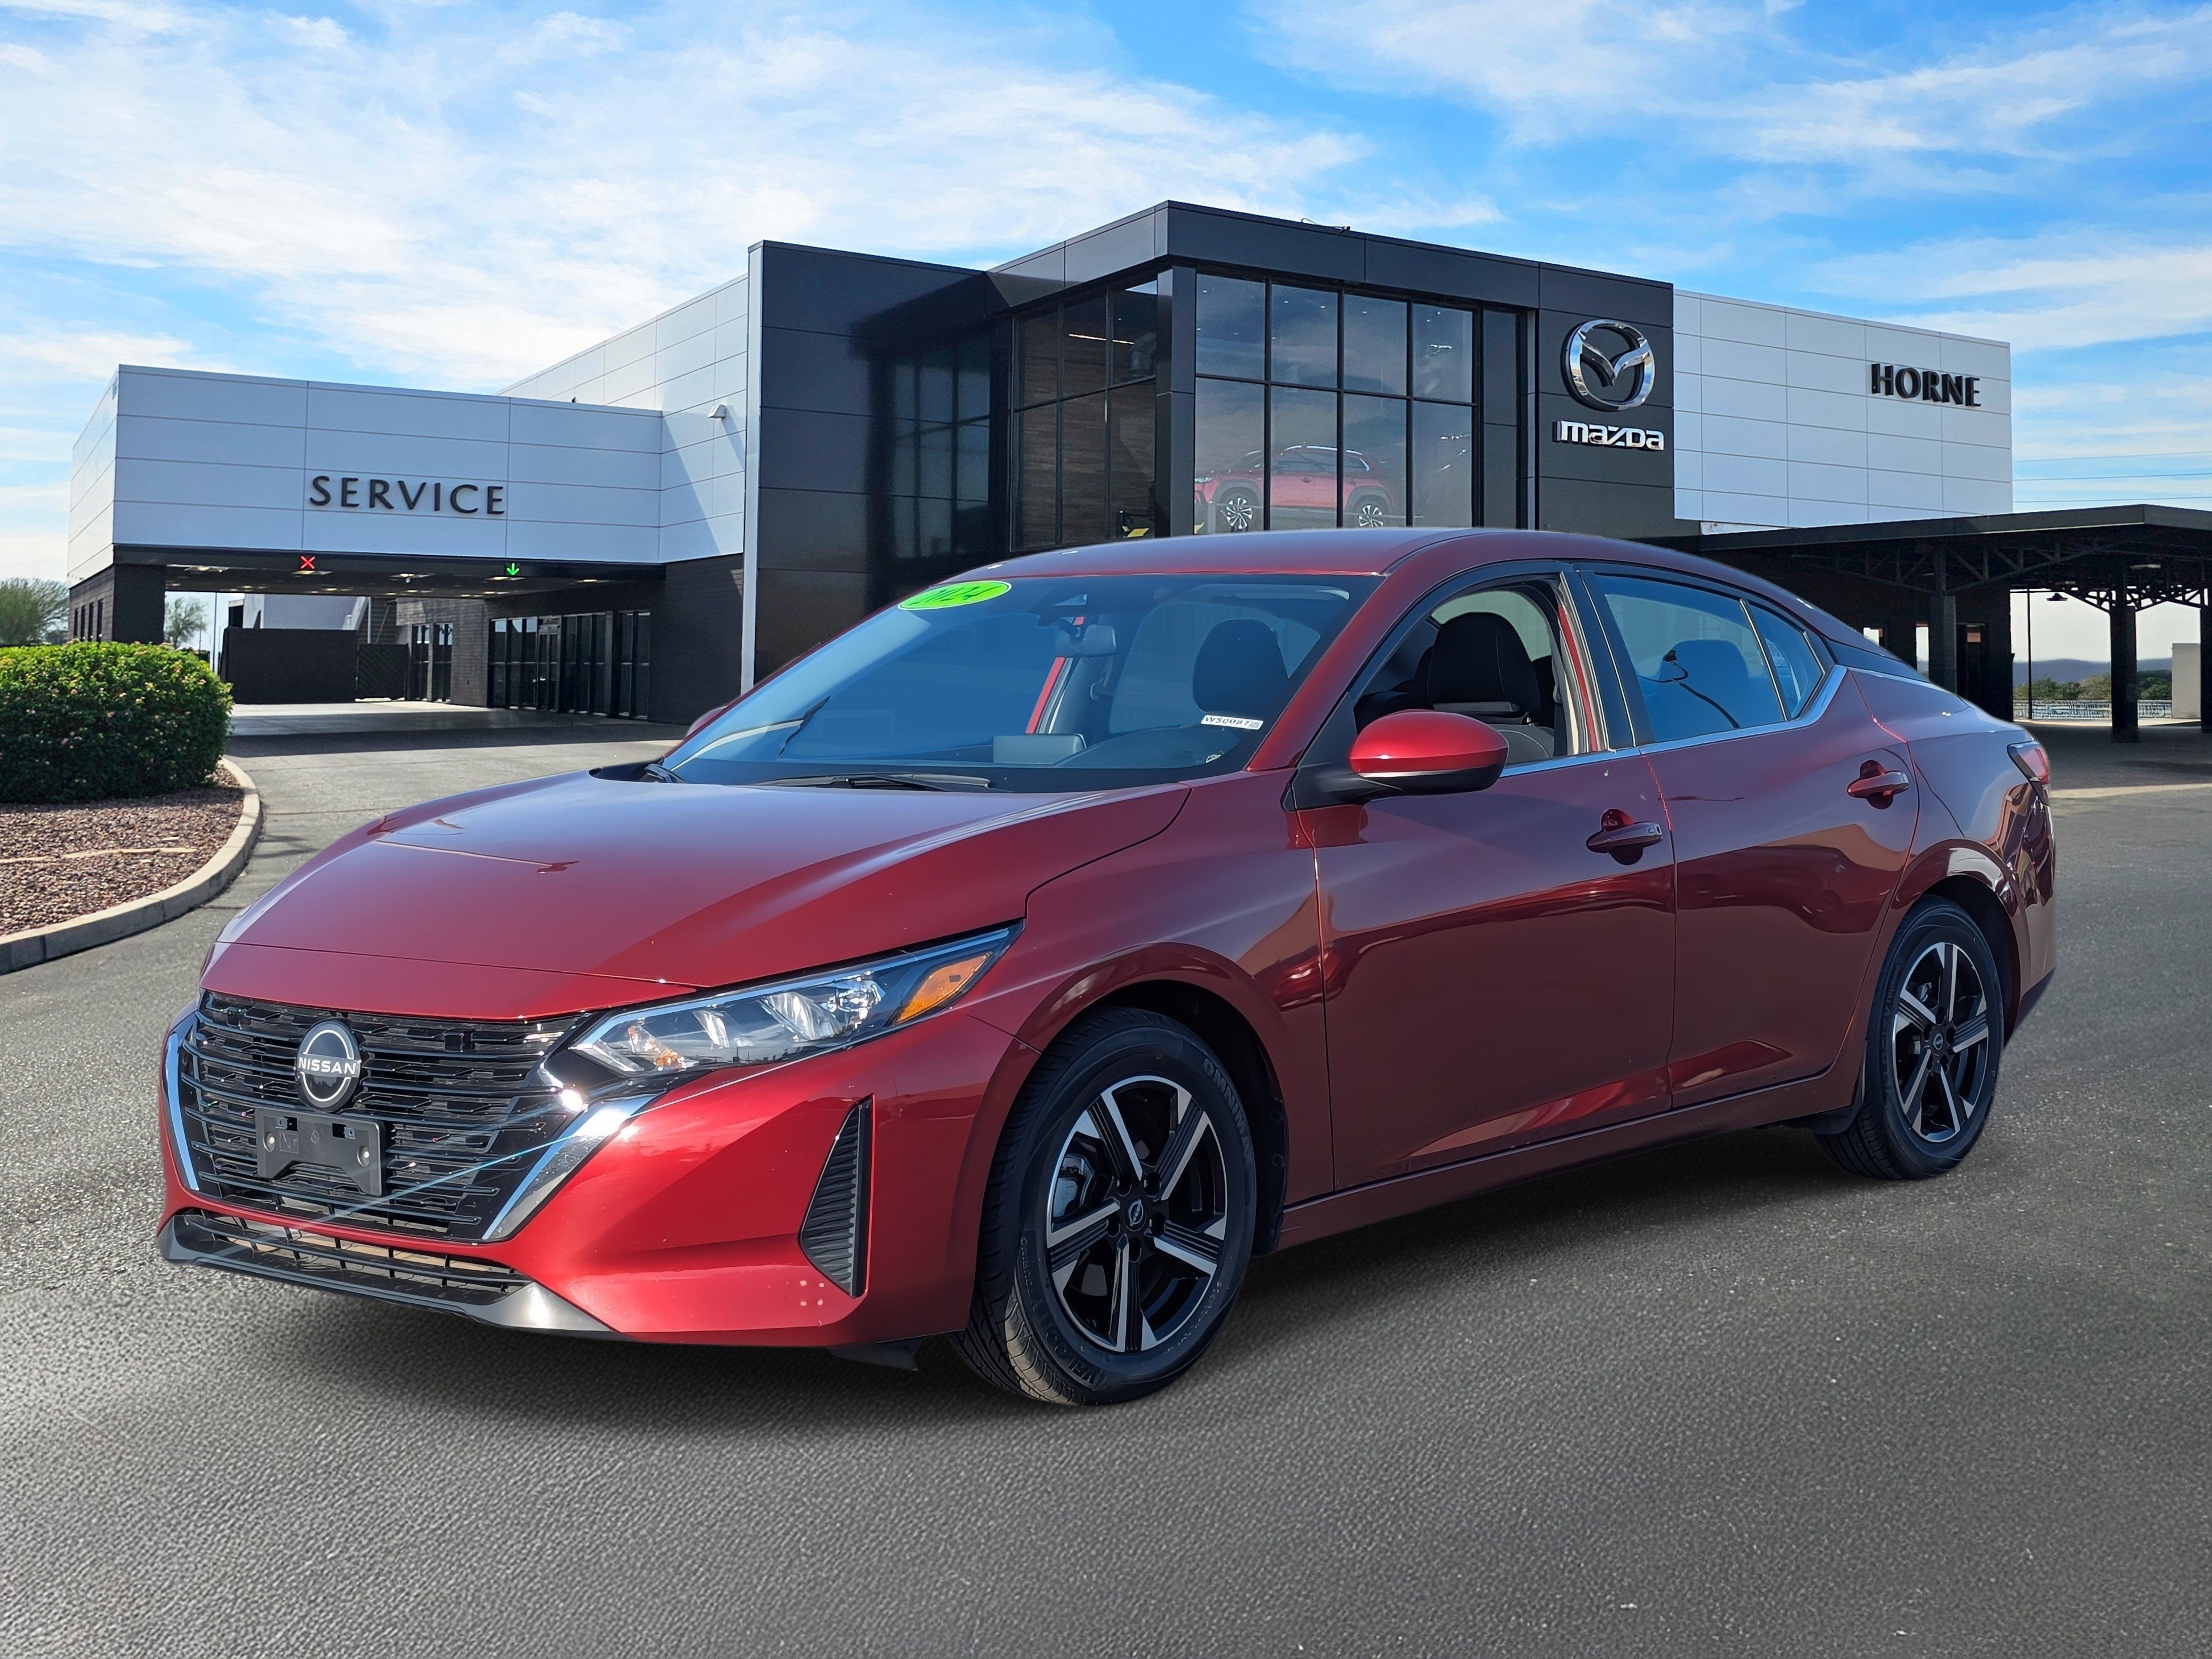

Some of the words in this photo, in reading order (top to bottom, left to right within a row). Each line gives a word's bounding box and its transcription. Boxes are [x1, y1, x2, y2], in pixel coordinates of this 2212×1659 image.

[1872, 363, 1981, 407] HORNE
[310, 475, 505, 515] SERVICE
[298, 1056, 357, 1075] NISSAN
